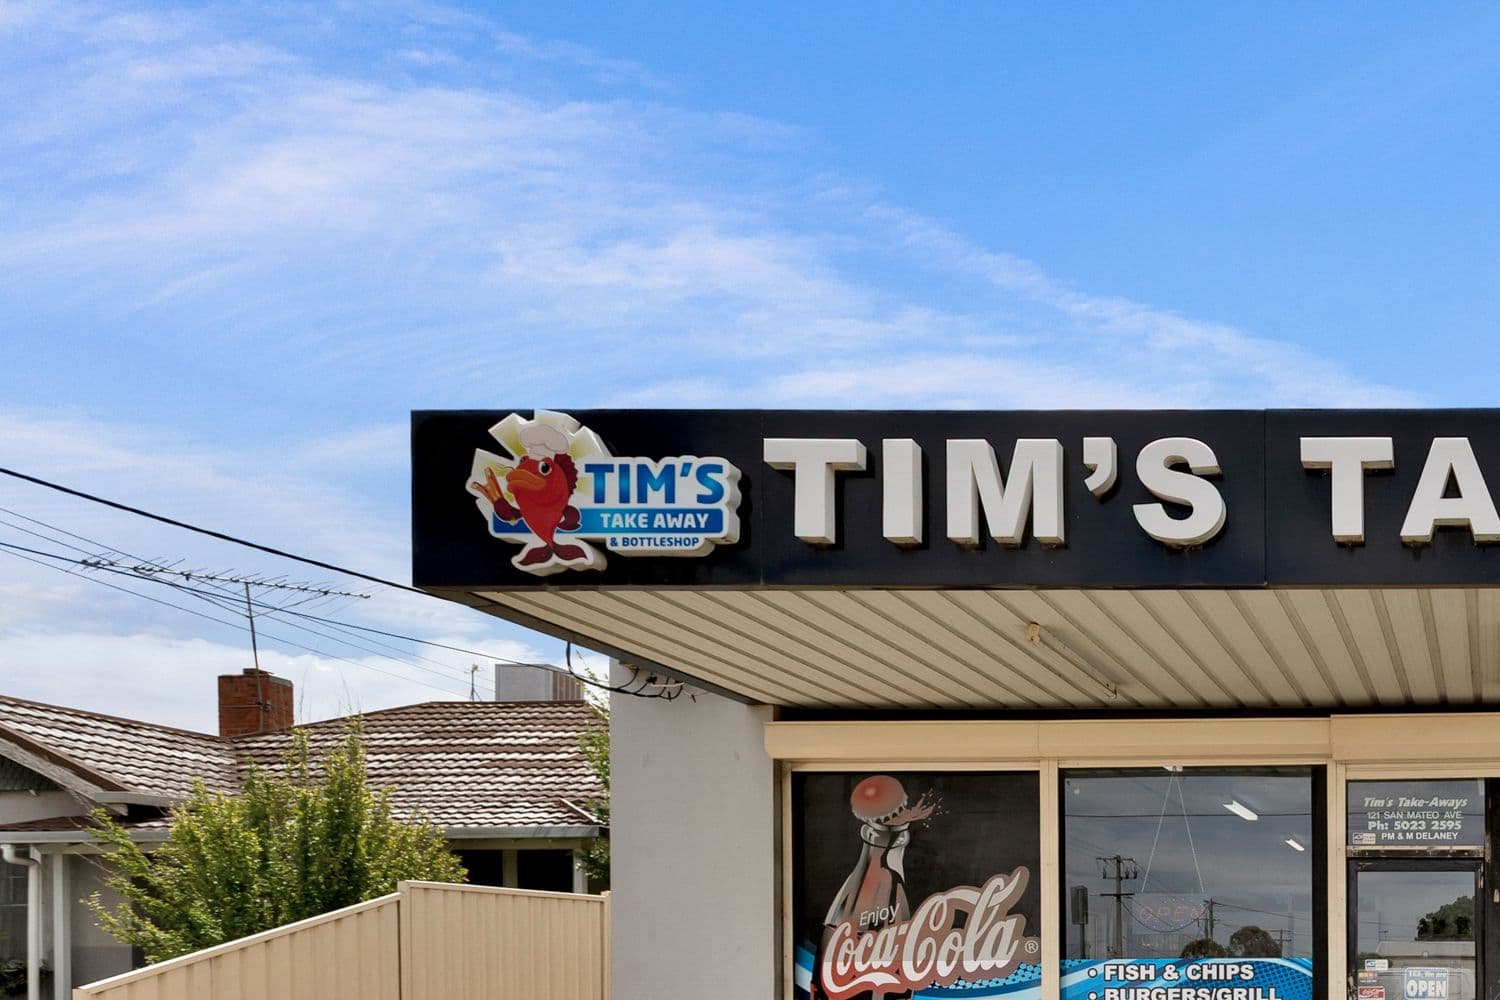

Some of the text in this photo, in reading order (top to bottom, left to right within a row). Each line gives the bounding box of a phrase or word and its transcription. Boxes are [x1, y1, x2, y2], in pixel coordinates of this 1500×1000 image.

[584, 462, 725, 505] TIM'S
[763, 437, 1227, 547] TIM'S
[600, 513, 709, 529] TAKE AWAY
[610, 537, 700, 547] & BOTTLESHOP
[1363, 797, 1468, 809] Tim's Take-Aways
[1367, 811, 1380, 819] 121
[1383, 811, 1404, 819] SAN
[1406, 811, 1440, 819] MATEO
[1367, 821, 1462, 830] Ph: 5023 2595
[1406, 832, 1414, 840] M
[1416, 832, 1459, 840] DELANEY
[859, 902, 900, 927] Enjoy
[823, 871, 1020, 993] Coca-Cola
[1104, 964, 1255, 981] FISH & CHIPS
[1406, 980, 1447, 997] OPEN
